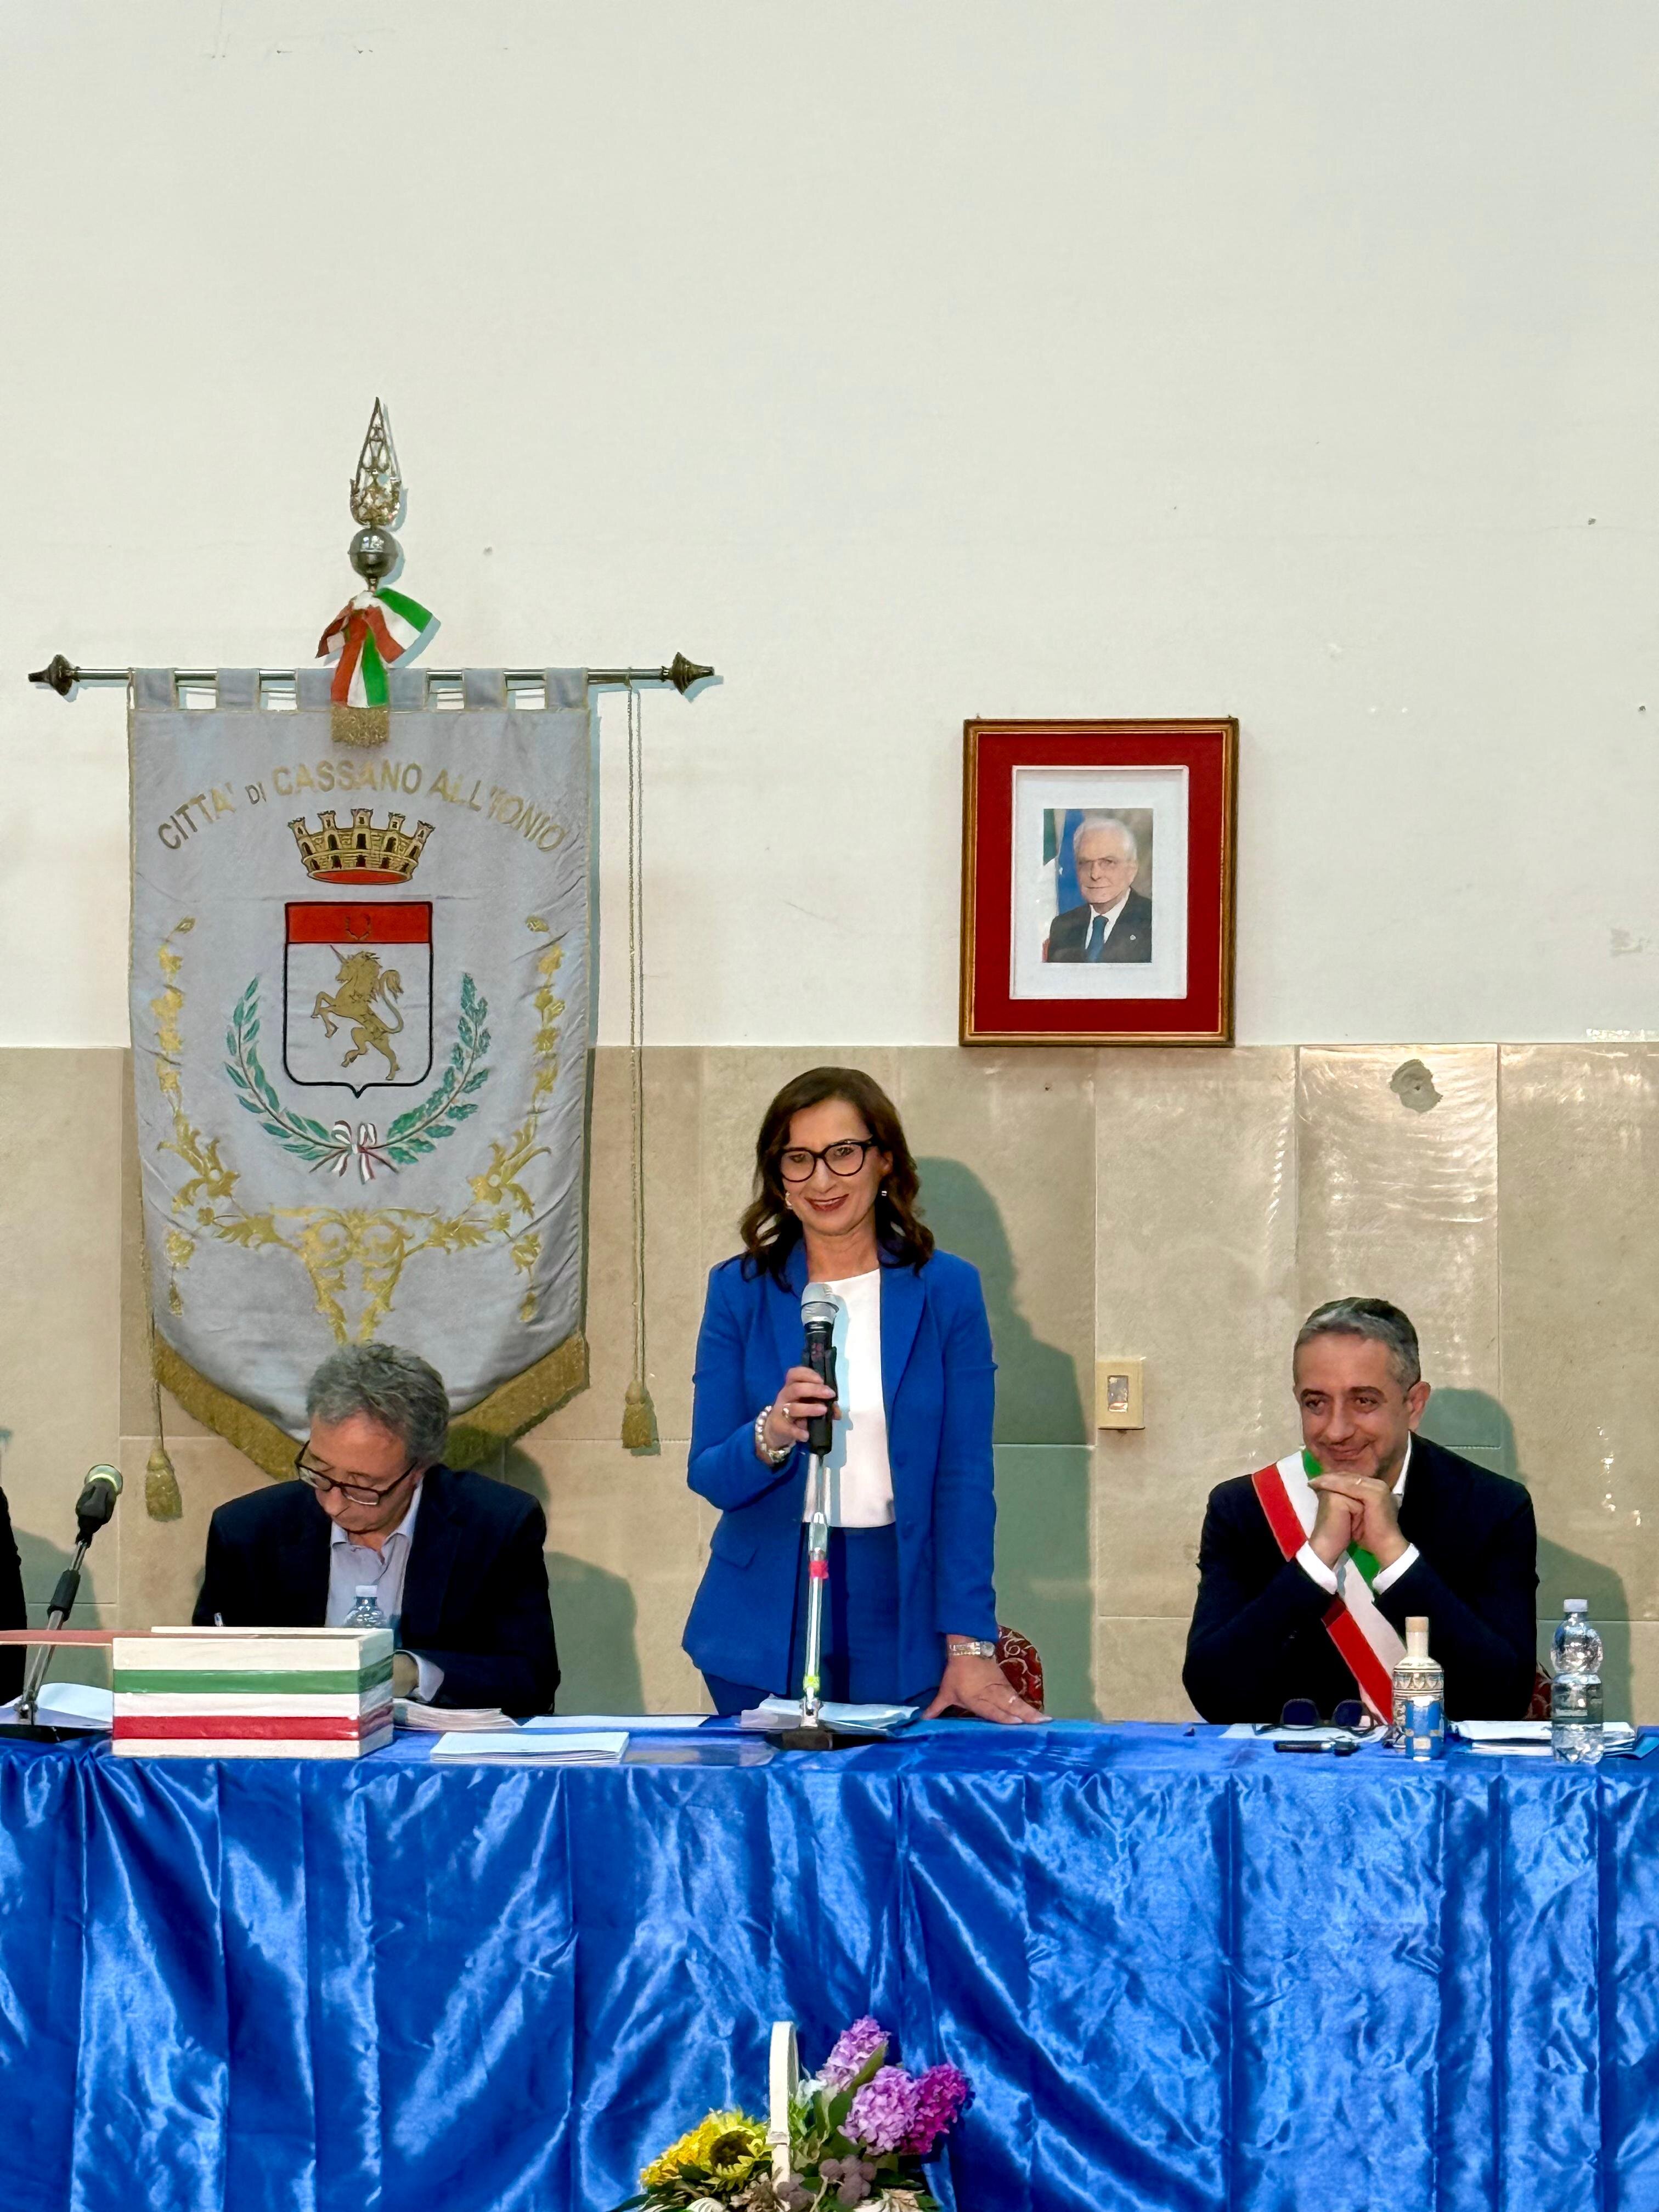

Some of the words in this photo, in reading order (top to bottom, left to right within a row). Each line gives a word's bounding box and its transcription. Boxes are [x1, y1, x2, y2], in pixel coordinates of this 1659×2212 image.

[158, 782, 236, 849] CITTA'
[245, 781, 267, 805] DI
[272, 759, 422, 795] CASSANO
